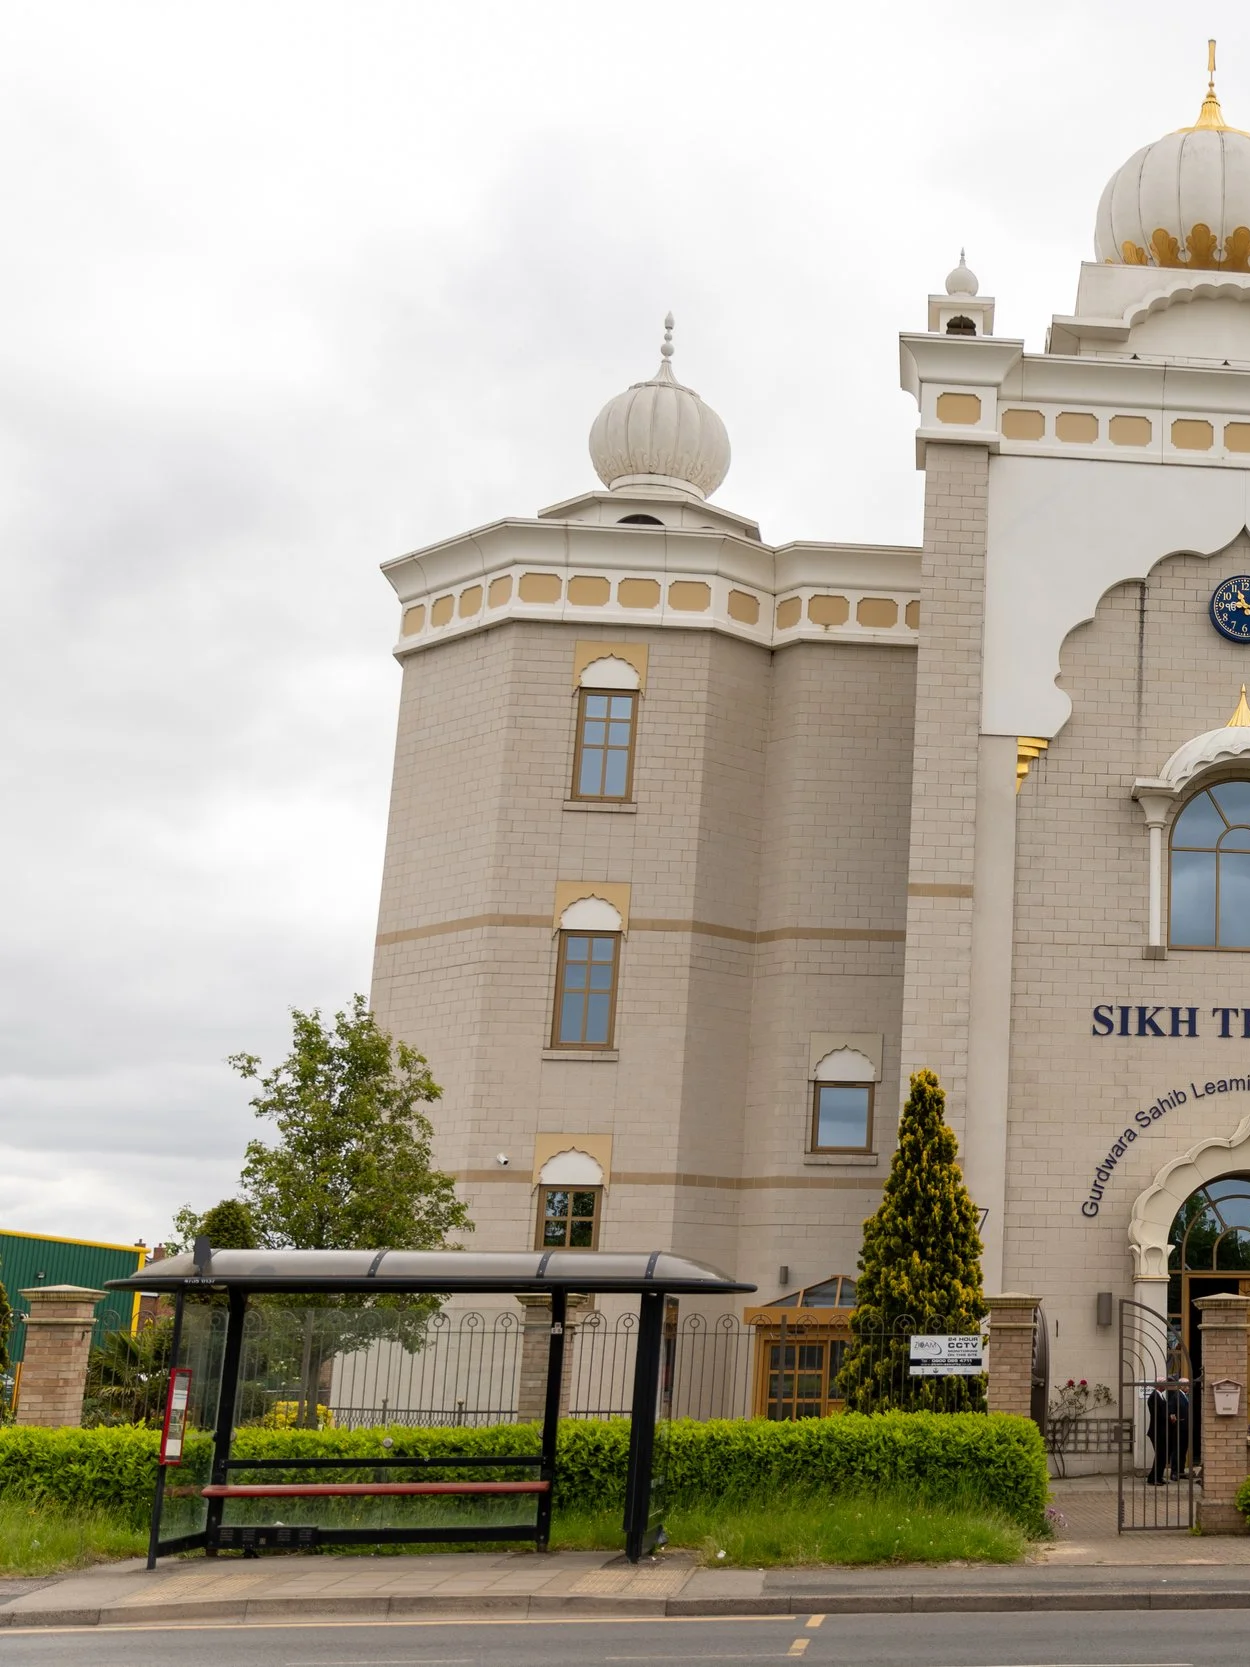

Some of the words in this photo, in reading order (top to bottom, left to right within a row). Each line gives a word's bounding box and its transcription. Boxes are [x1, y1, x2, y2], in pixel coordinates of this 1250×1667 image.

[1241, 582, 1249, 590] 12
[1223, 592, 1231, 600] 10
[1219, 602, 1224, 610] 9
[1223, 613, 1228, 621] 8
[1231, 621, 1236, 629] 7
[1242, 624, 1248, 632] 6
[1091, 1004, 1200, 1038] SIKH
[1081, 1127, 1138, 1219] Gurdwara
[1134, 1088, 1188, 1128] Sahib
